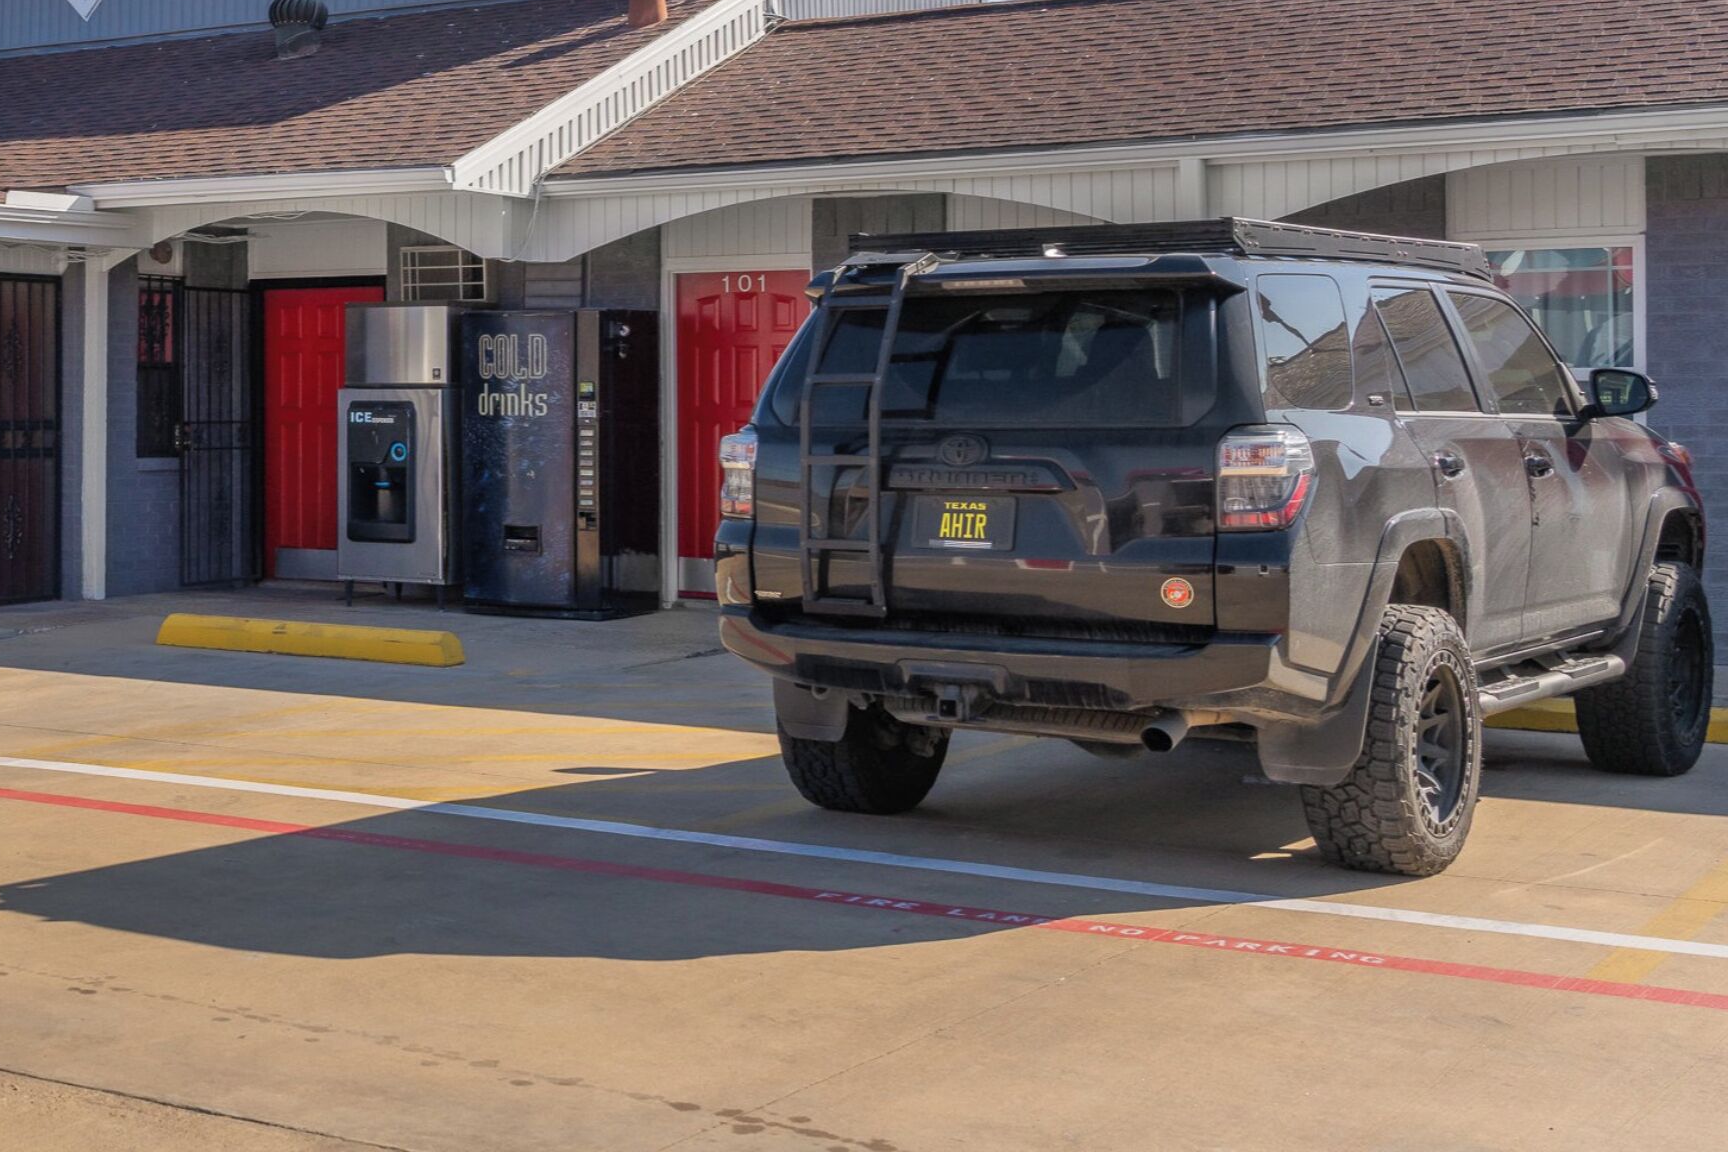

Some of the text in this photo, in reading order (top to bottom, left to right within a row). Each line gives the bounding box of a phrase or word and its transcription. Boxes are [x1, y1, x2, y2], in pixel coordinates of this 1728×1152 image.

[722, 274, 765, 293] 101
[478, 334, 547, 379] COLD
[478, 383, 548, 416] drinks
[350, 411, 372, 423] ICE
[944, 501, 987, 510] TEXAS
[939, 512, 987, 539] AHIR
[815, 891, 921, 910] FIRE
[1088, 924, 1145, 936] NO
[1172, 934, 1385, 964] PARKING
